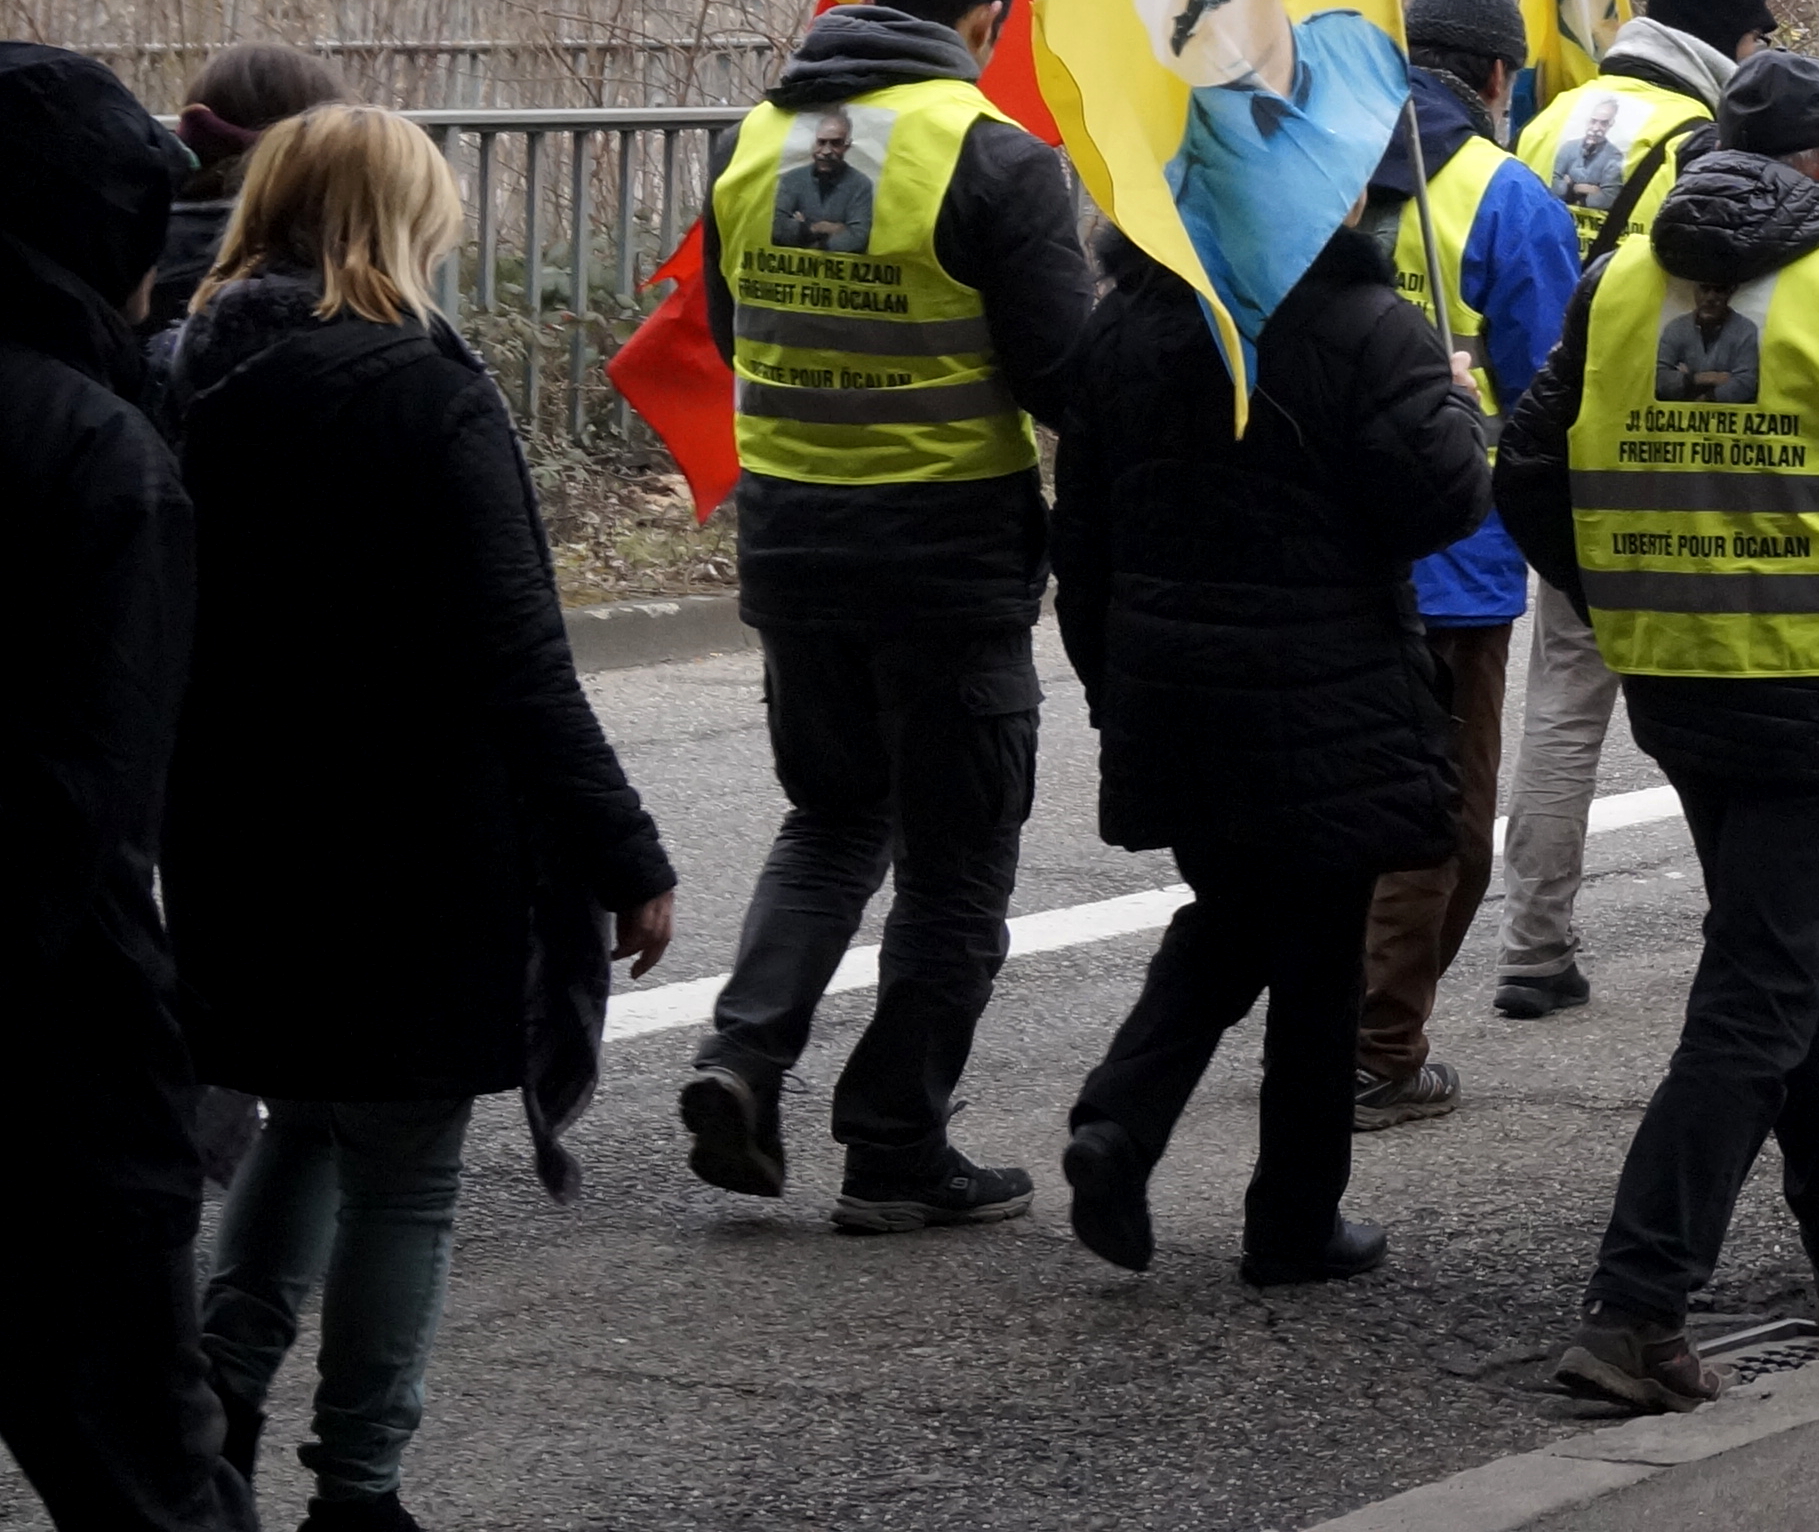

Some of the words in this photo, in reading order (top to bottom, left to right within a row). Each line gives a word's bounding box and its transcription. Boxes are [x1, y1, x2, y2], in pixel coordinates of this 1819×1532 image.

[850, 262, 902, 286] AZADI
[800, 282, 833, 308] FÜR
[838, 284, 909, 315] ÖCALAN
[1625, 408, 1641, 433] JI
[1743, 412, 1799, 437] AZADI
[1619, 440, 1685, 464] FREIHEIT
[1690, 436, 1726, 466] FÜR
[1730, 438, 1807, 468] ÖCALAN
[1613, 530, 1674, 557] LIBERTÉ
[1677, 534, 1727, 559] POUR
[1733, 531, 1811, 559] ÖCALAN
